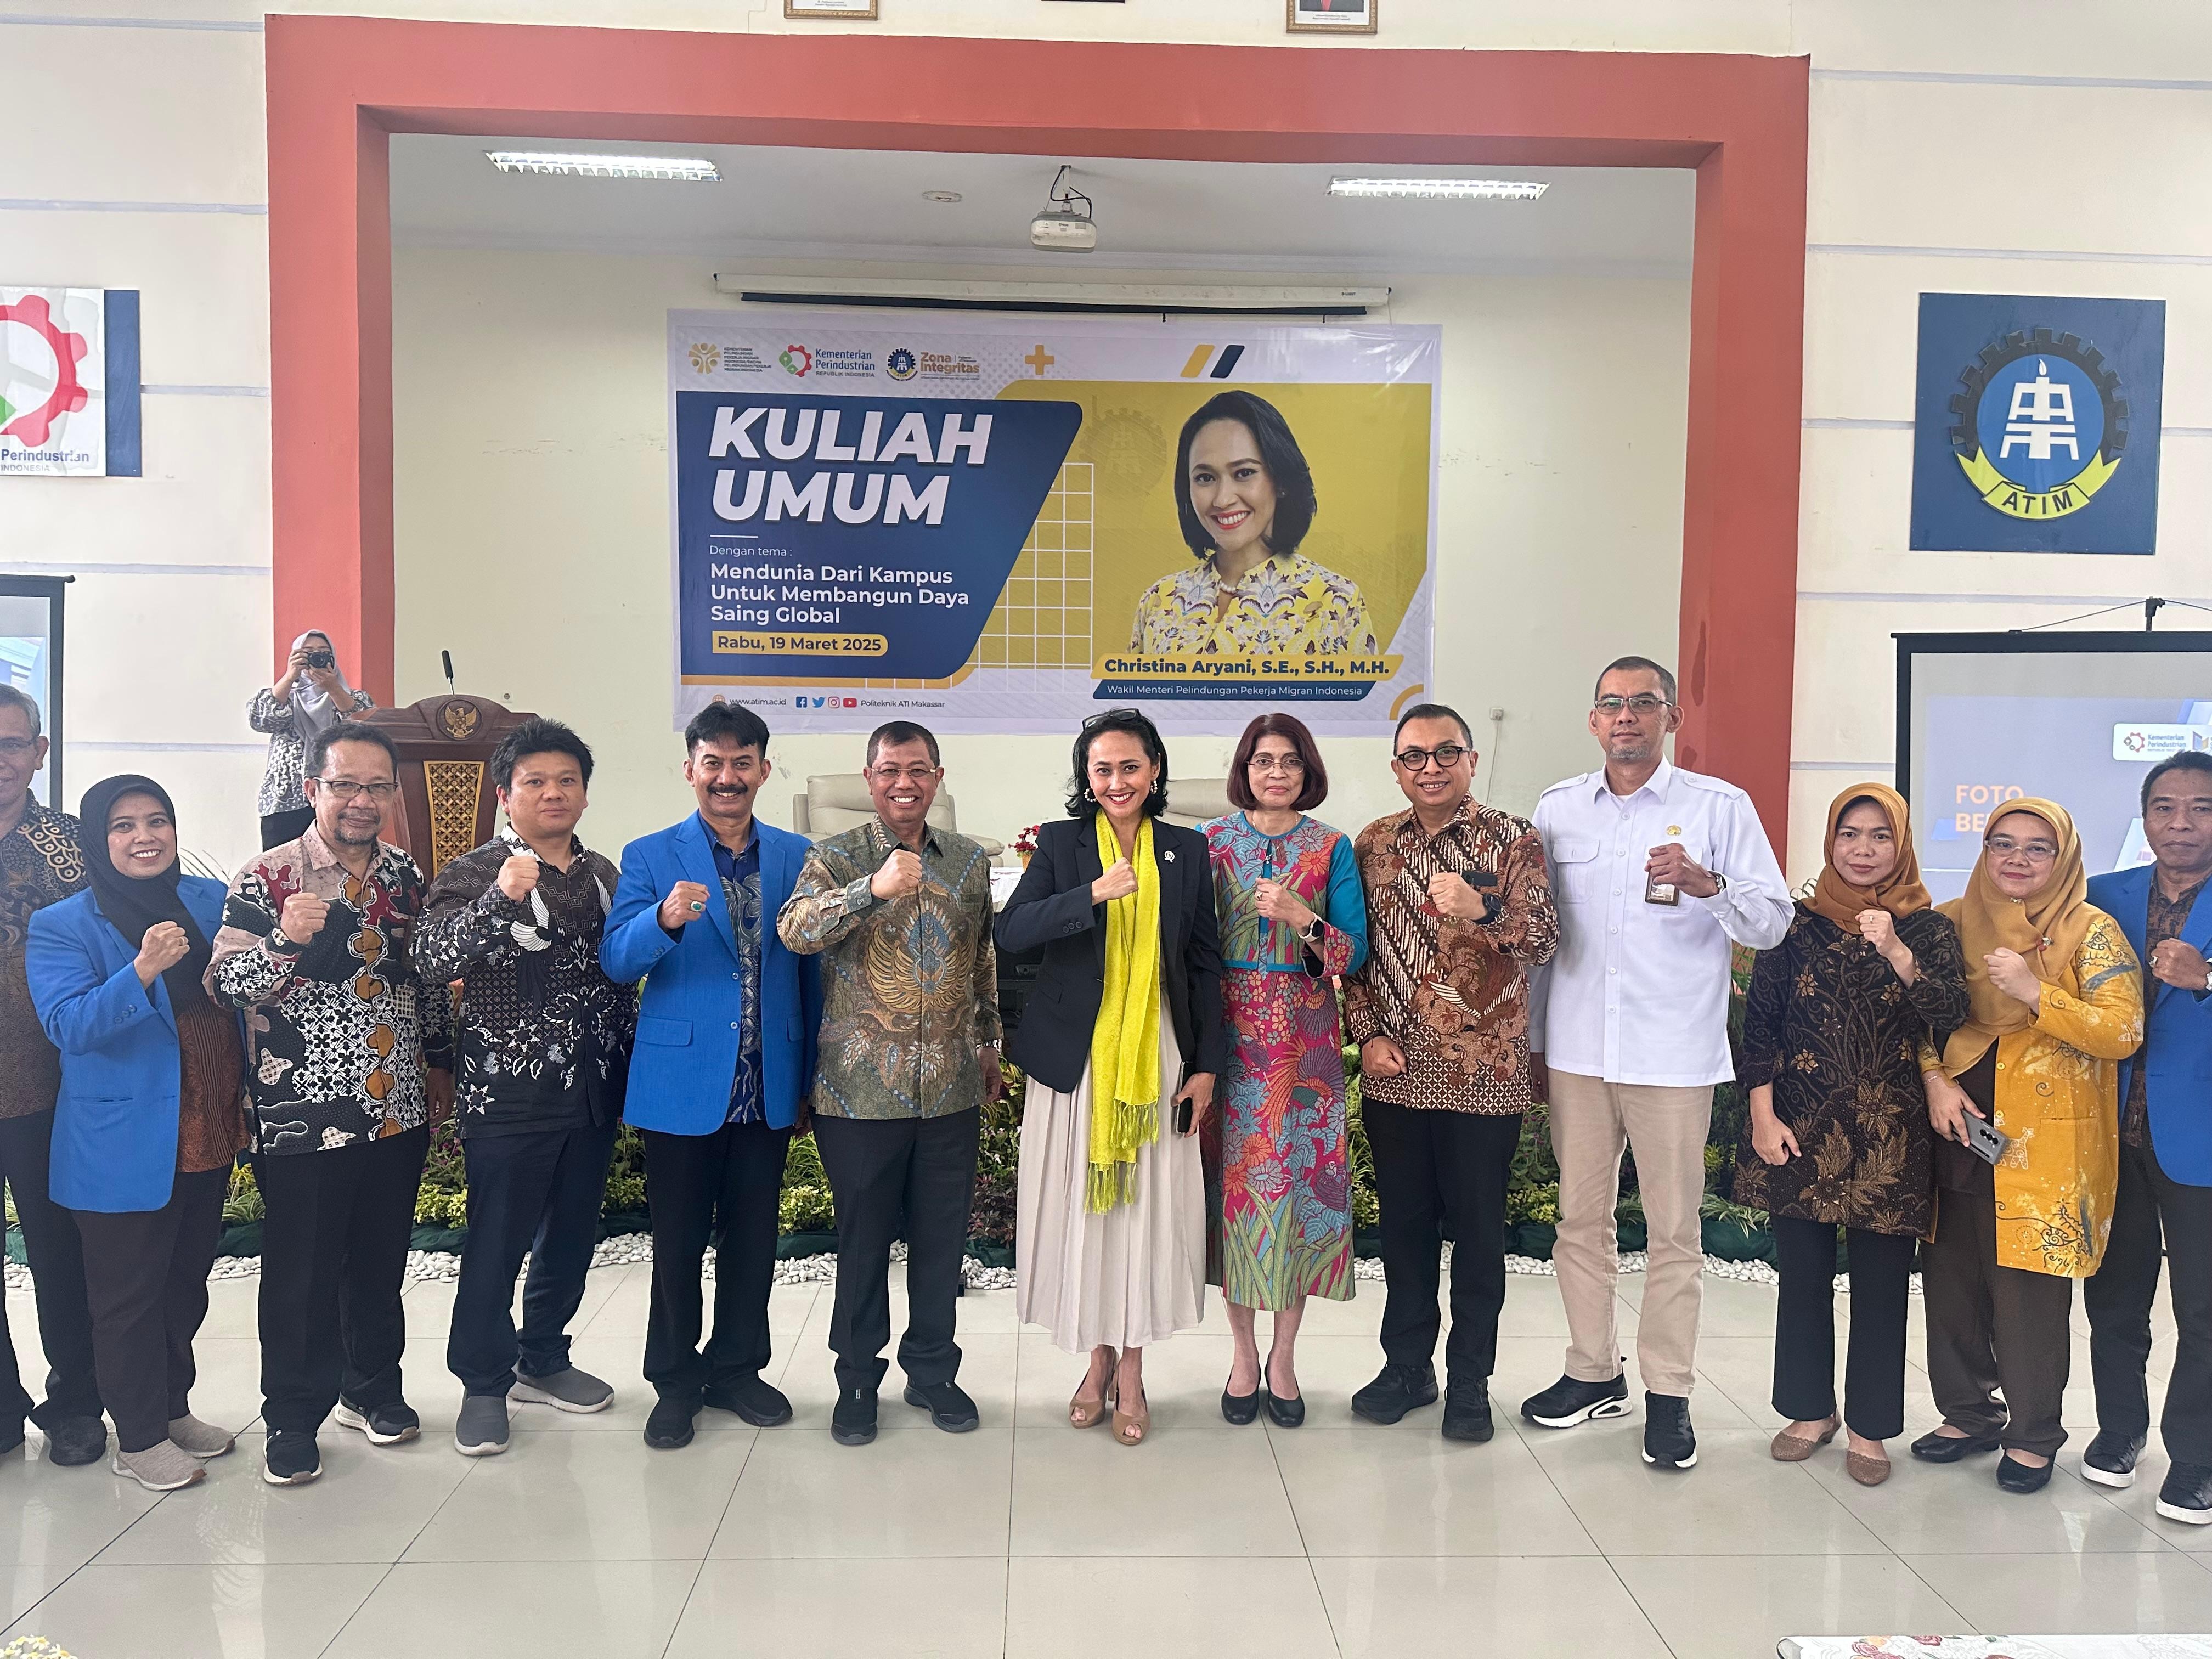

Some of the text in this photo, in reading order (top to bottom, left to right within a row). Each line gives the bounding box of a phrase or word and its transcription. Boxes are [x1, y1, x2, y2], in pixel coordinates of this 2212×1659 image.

[815, 348, 872, 359] Kementerian
[920, 352, 952, 363] Zona
[815, 359, 876, 370] Perindustrian
[920, 362, 980, 374] Integritas
[708, 406, 994, 464] KULIAH
[1, 449, 89, 462] Perindustrian
[712, 469, 950, 525] UMUM
[2001, 490, 2073, 515] ATIM
[710, 545, 754, 557] Dengan
[758, 546, 787, 557] tema
[710, 563, 953, 586] Mendunia Dari Kampus
[711, 584, 969, 609] Untuk Membangun Daya
[711, 605, 840, 625] Saing Global
[718, 636, 882, 652] Rabu, 19 Maret 2025
[1104, 658, 1390, 676] Christina Aryani, S.E., S.H., M.H.
[1107, 685, 1363, 697] Wakil Menteri Pelindungan Pekerja Migran Indonesia
[729, 697, 787, 706] www.atim.ac.id
[861, 699, 896, 708] Politeknik
[911, 700, 945, 708] Makassar
[1956, 784, 2024, 804] FOTO
